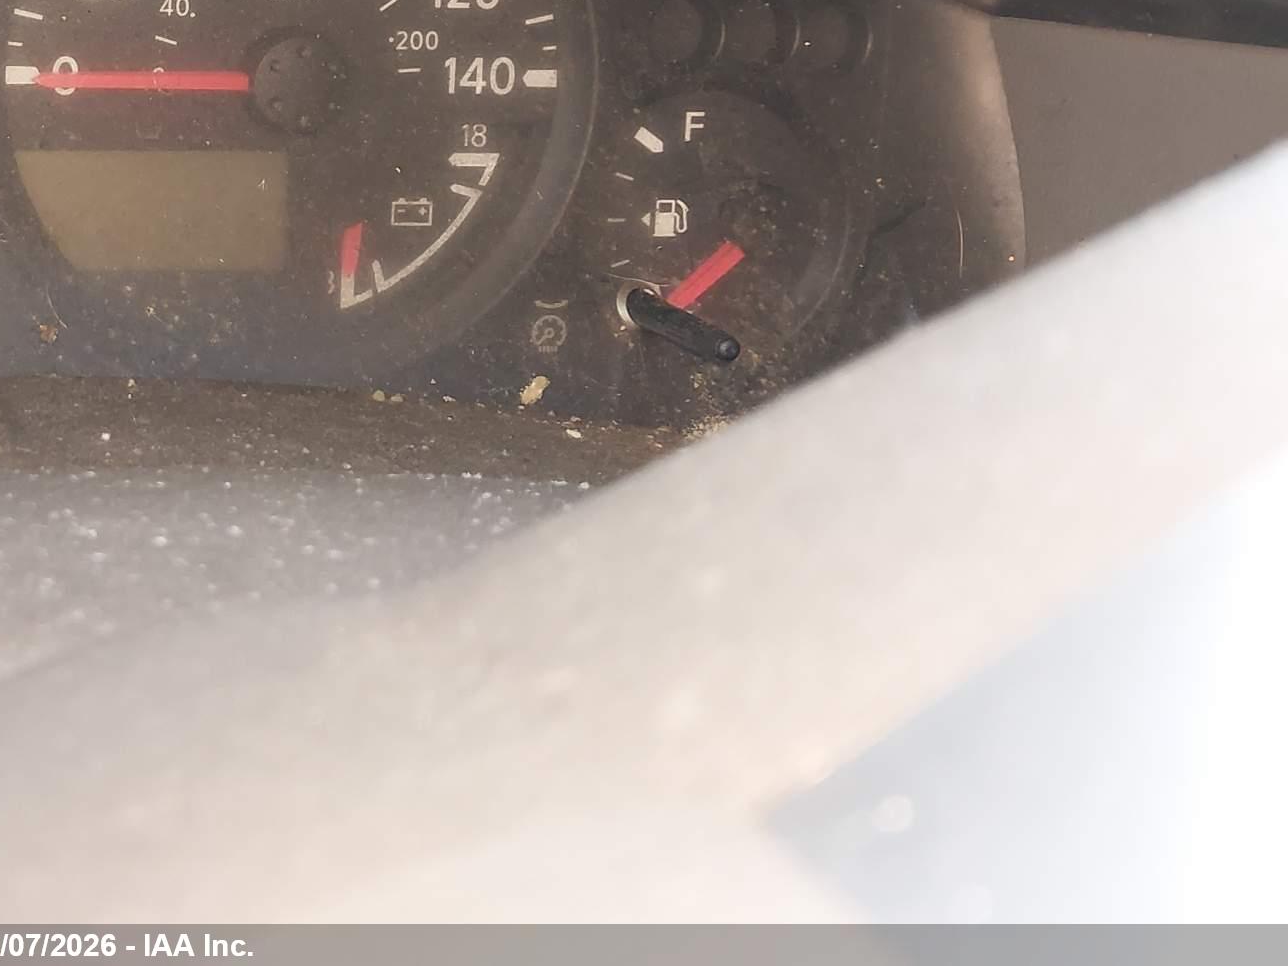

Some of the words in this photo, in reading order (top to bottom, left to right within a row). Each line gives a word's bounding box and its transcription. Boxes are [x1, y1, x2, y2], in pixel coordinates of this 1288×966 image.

[395, 30, 439, 52] 200
[52, 56, 79, 96] 0
[444, 56, 516, 95] 140
[461, 124, 488, 148] 18
[684, 111, 706, 143] F
